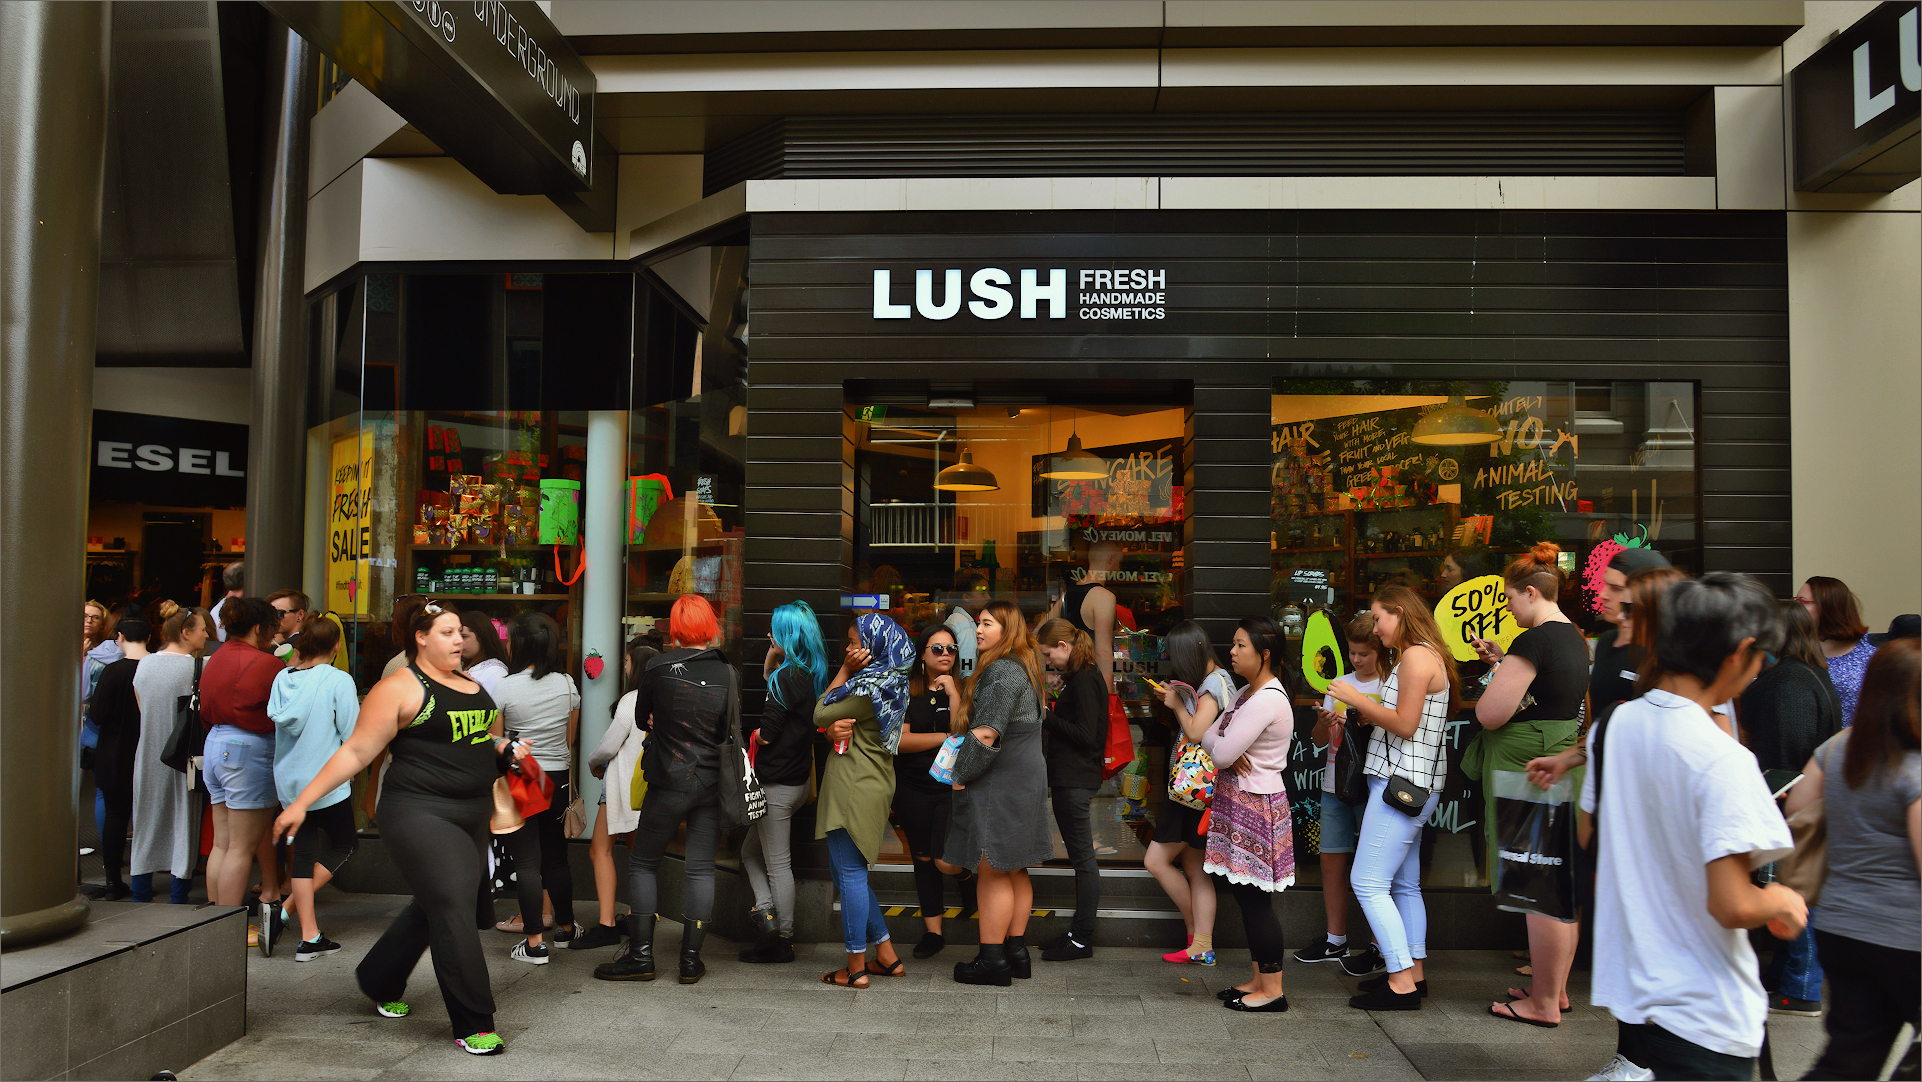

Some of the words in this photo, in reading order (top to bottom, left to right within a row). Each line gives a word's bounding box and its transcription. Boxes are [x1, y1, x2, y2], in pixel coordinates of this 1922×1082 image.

[873, 267, 1066, 320] LUSH
[1079, 269, 1166, 290] FRESH
[1079, 292, 1166, 305] HANDMADE
[1079, 307, 1166, 320] COSMETICS
[1333, 430, 1349, 442] YOUR
[1352, 416, 1380, 437] HAIR
[1337, 417, 1358, 431] FEED
[1343, 437, 1360, 449] WITH
[1363, 428, 1385, 443] MORE
[1490, 416, 1543, 458] NO
[98, 440, 245, 478] ESEL
[1338, 443, 1372, 464] FRUIT
[1385, 432, 1411, 451] VEG
[1376, 452, 1398, 465] LOCAL
[1473, 459, 1553, 490] ANIMAL
[332, 487, 371, 523] FRESH
[1496, 480, 1579, 511] TESTING
[331, 526, 370, 563] SALE
[1451, 580, 1507, 618] 50%
[1461, 605, 1508, 644] OFF
[1112, 661, 1159, 674] LUSH
[1529, 852, 1563, 866] Store
